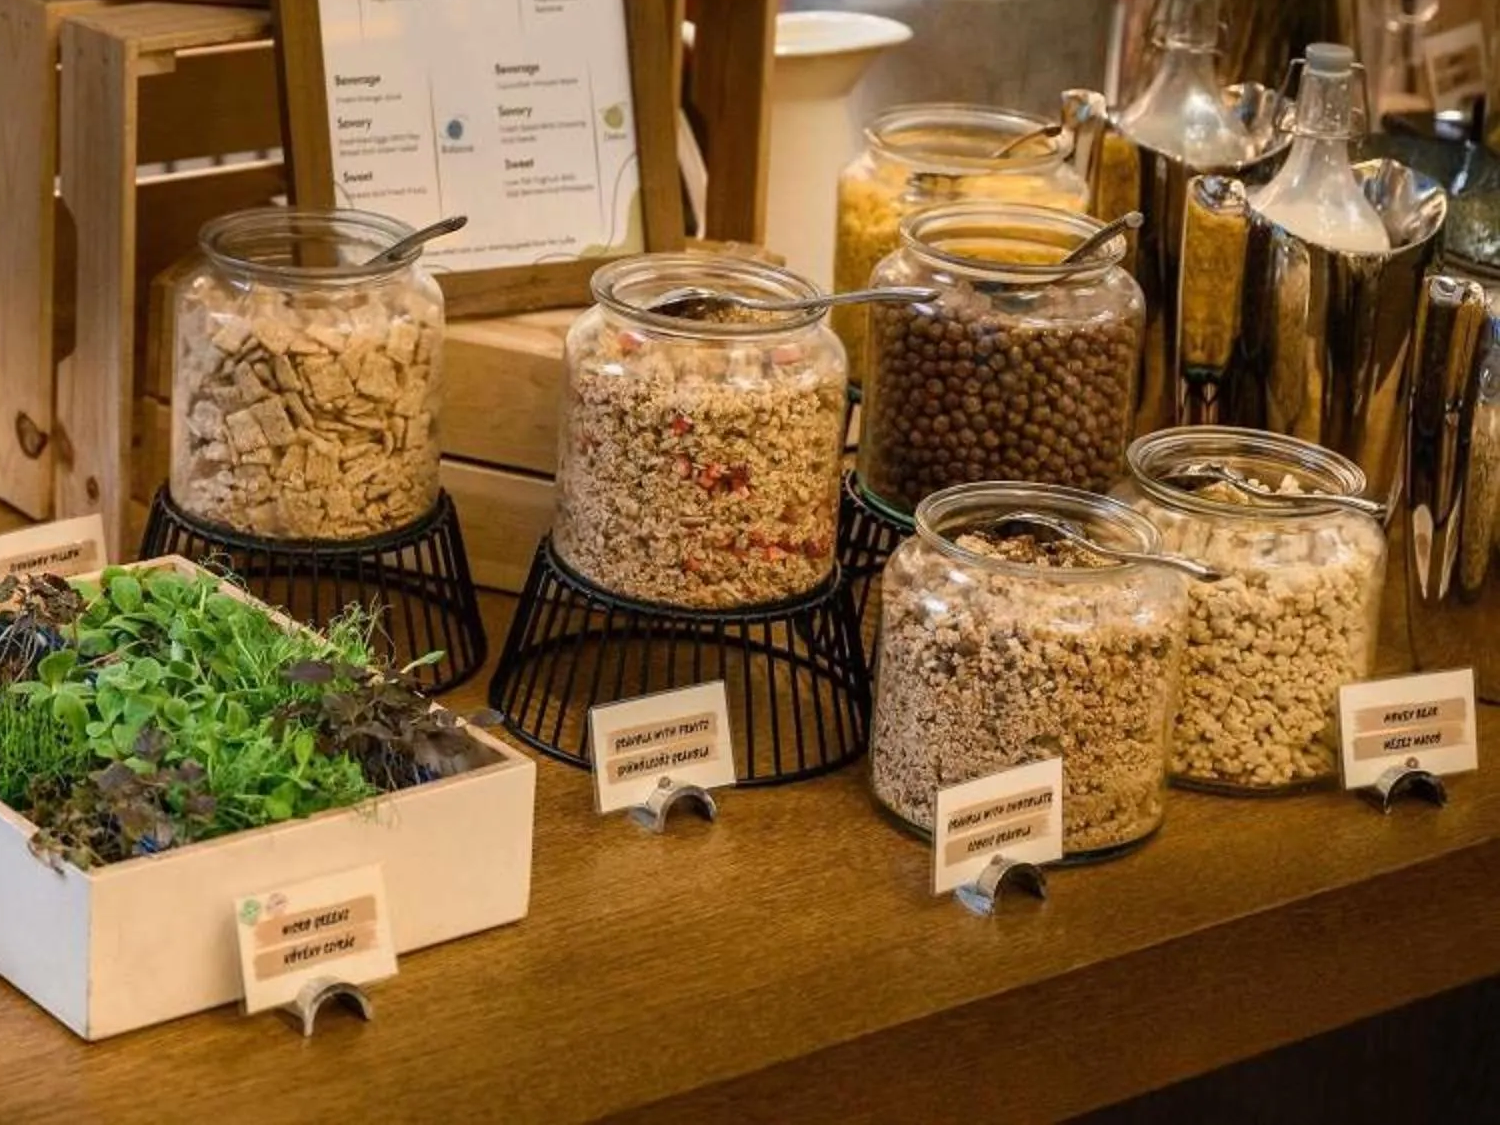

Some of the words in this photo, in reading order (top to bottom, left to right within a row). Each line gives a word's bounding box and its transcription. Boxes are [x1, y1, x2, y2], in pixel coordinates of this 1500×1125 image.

[495, 63, 540, 76] Beverage
[334, 74, 381, 87] Beverage
[337, 116, 372, 132] Savory
[343, 171, 373, 183] Sweet
